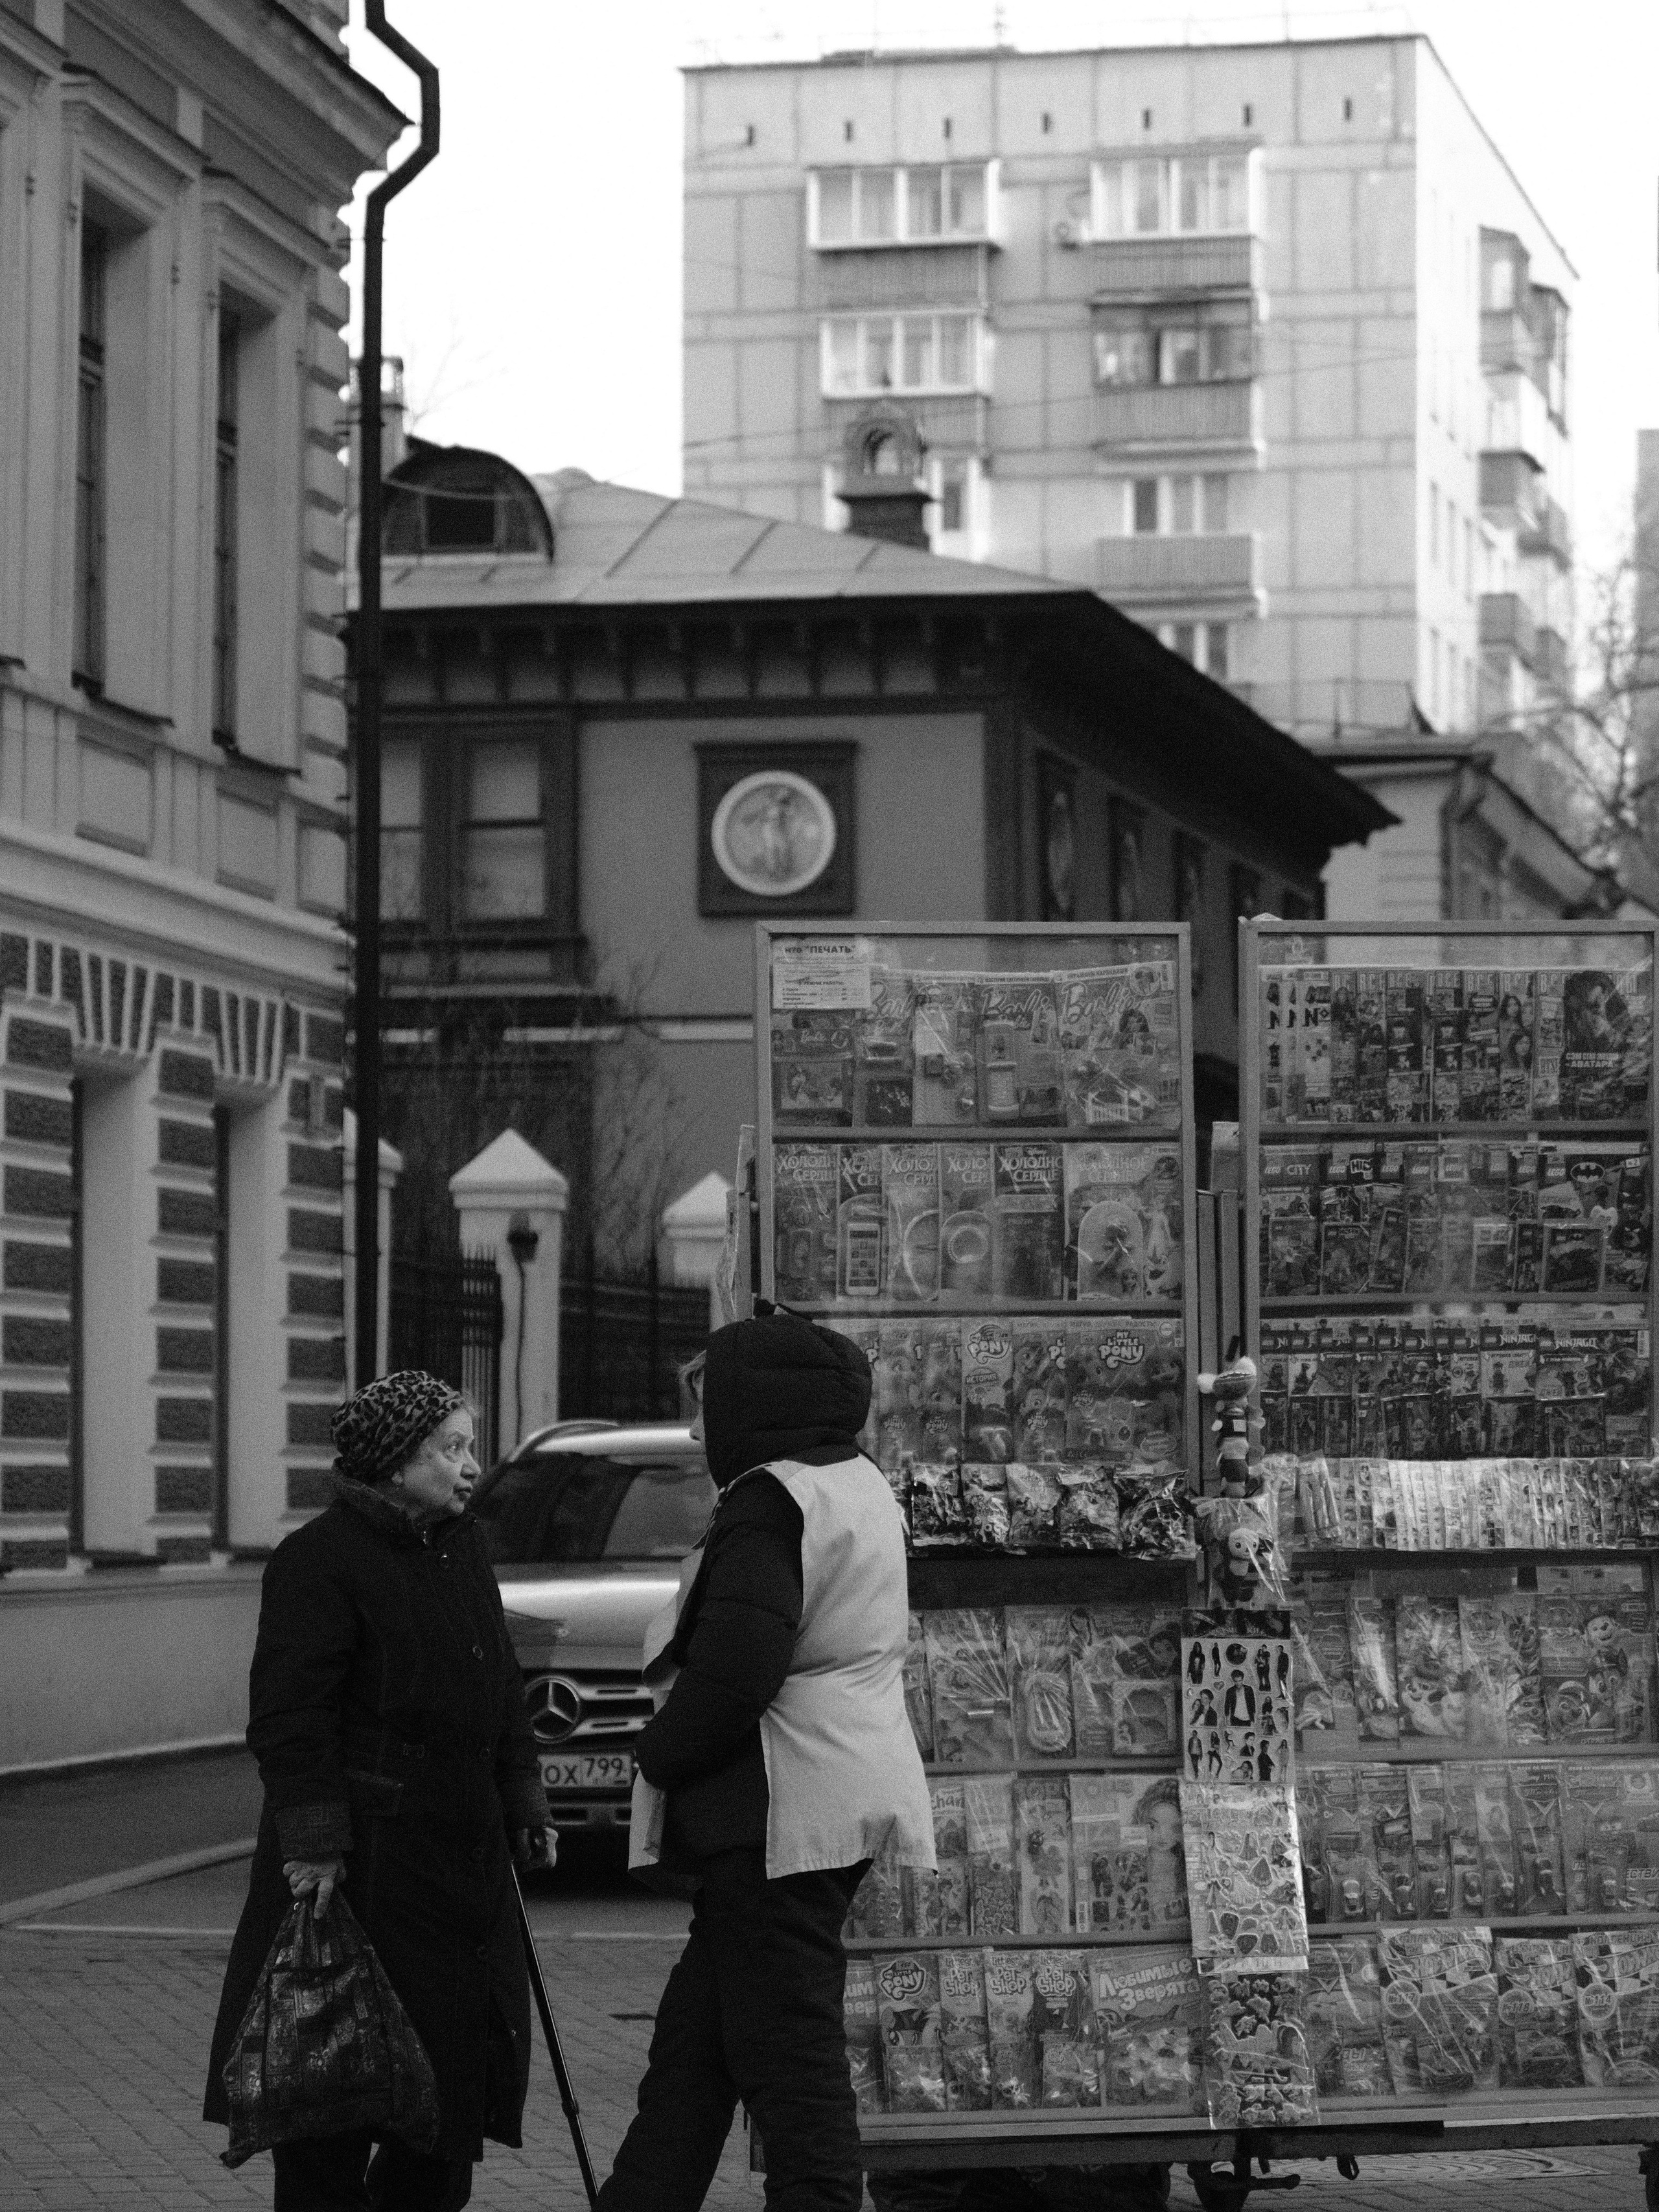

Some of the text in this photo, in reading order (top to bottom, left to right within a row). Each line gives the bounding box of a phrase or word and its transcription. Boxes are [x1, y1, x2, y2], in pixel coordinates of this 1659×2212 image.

[1286, 1163, 1312, 1176] CITY
[1098, 1345, 1144, 1369] PONY
[584, 1757, 623, 1778] 799
[882, 1971, 923, 1999] PONY
[1118, 1978, 1200, 2011] Зверята
